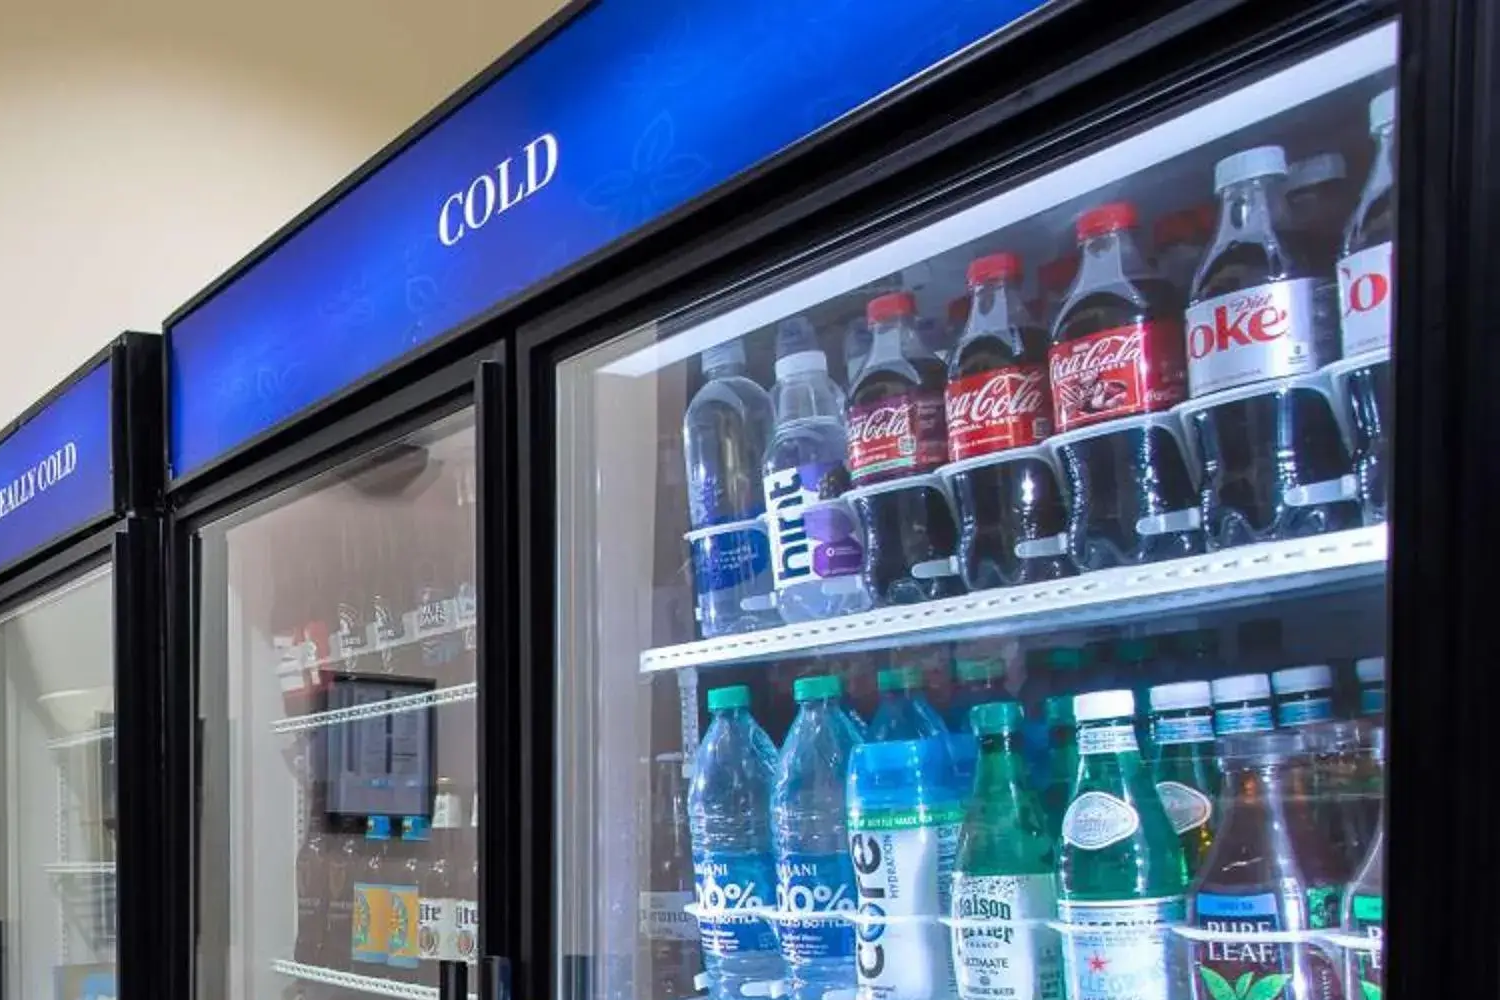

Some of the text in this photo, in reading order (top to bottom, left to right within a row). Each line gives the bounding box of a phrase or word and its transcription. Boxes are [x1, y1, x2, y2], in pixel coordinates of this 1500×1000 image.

[438, 132, 558, 247] COLD
[1187, 303, 1288, 360] oke
[37, 441, 77, 491] COLD
[769, 472, 812, 581] hint
[852, 832, 887, 980] core
[959, 895, 1011, 920] aison
